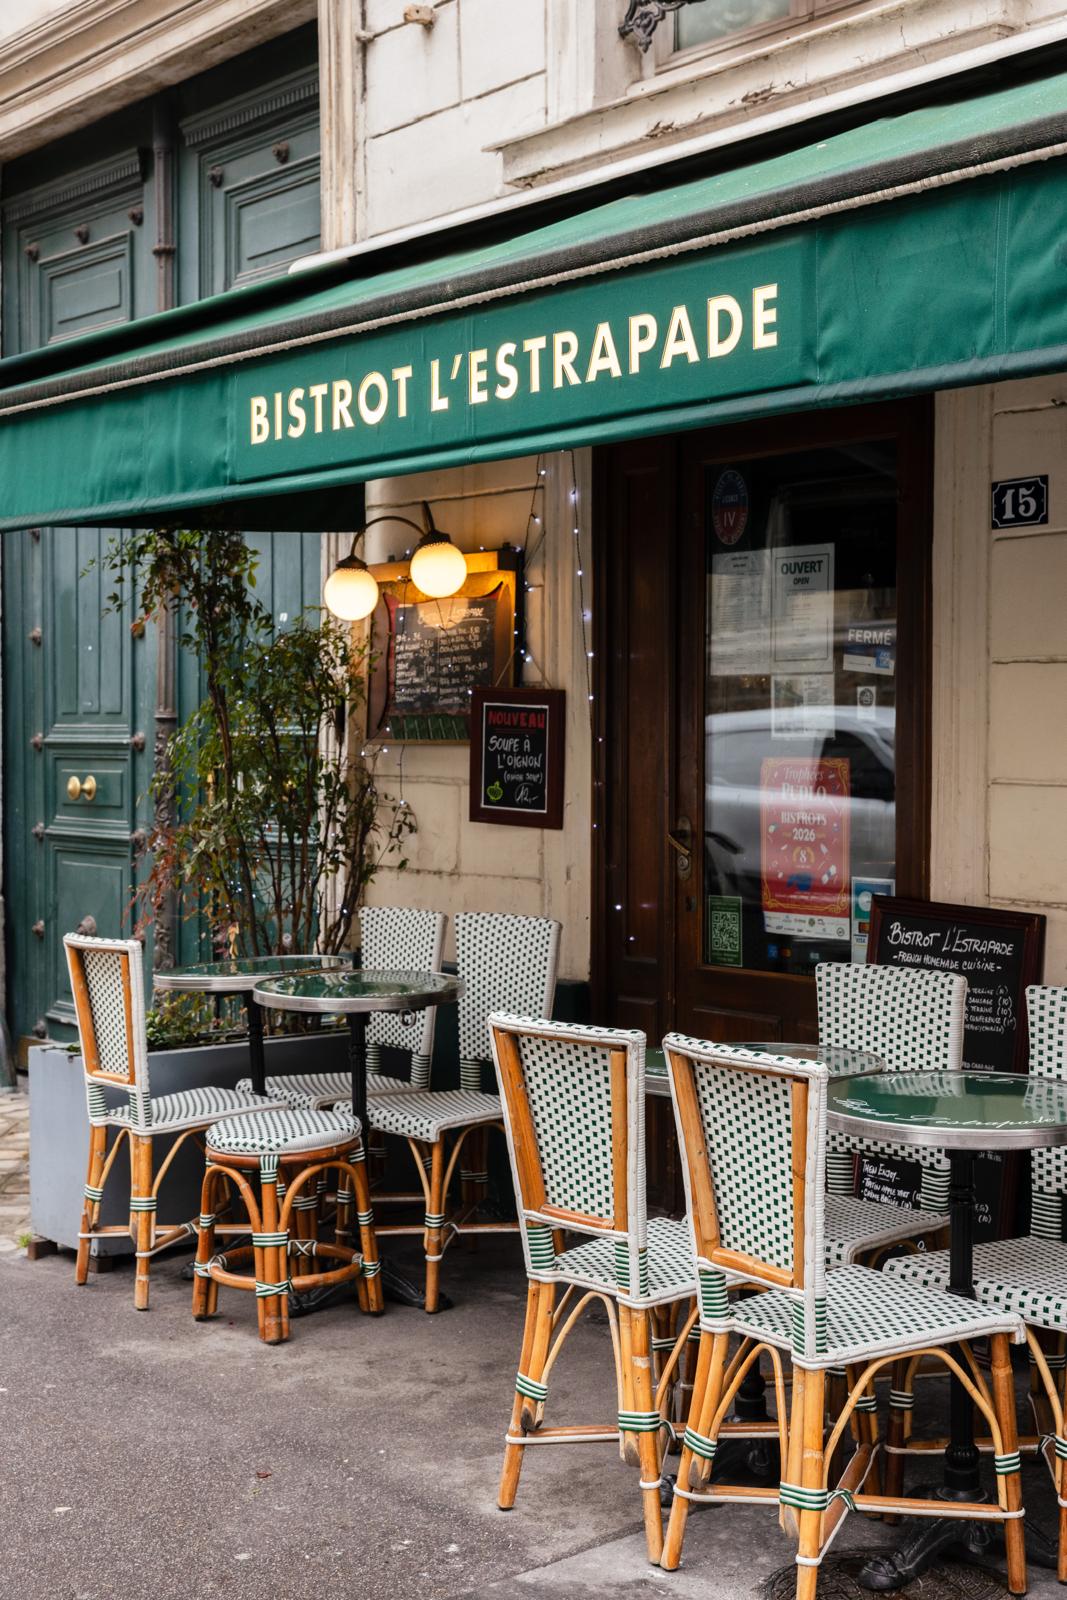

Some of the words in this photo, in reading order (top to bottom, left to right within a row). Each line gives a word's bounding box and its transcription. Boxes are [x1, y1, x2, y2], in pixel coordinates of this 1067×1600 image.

[250, 365, 413, 446] BISTROT
[430, 283, 778, 413] L'ESTRAPADE
[1001, 486, 1037, 520] 15
[723, 511, 736, 529] IV
[781, 560, 824, 575] OUVERT
[793, 577, 810, 586] OPEN
[848, 629, 893, 646] FERMÉ
[488, 711, 545, 729] NOUVEAU
[488, 735, 520, 752] SOUPE
[523, 734, 531, 753] À
[783, 766, 824, 783] Trophées
[781, 811, 828, 826] BISTROTS
[792, 824, 816, 842] 2026
[799, 853, 807, 865] 8
[923, 954, 959, 970] HOMEMADE
[996, 1006, 1012, 1018] (10)
[862, 1158, 877, 1174] THEN
[881, 1185, 896, 1196] APPLE
